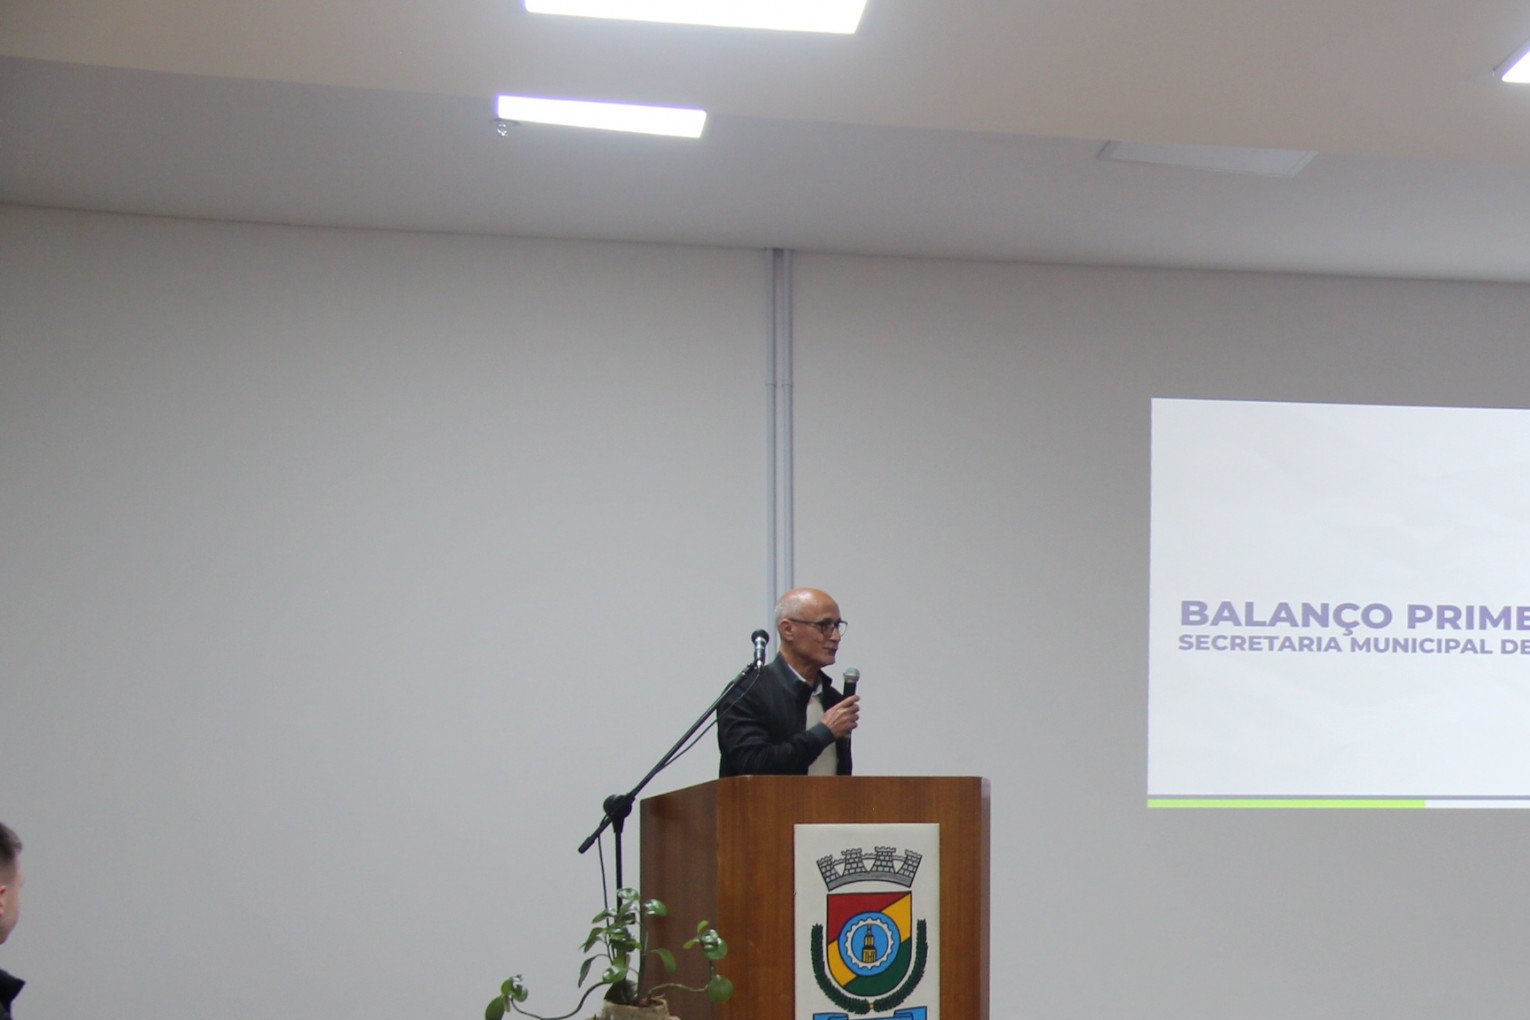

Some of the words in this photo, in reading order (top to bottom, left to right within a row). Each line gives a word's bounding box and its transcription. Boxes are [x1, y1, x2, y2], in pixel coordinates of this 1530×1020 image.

[1180, 600, 1393, 636] BALANÇO
[1178, 633, 1343, 652] SECRETARIA
[1350, 636, 1493, 654] MUNICIPAL
